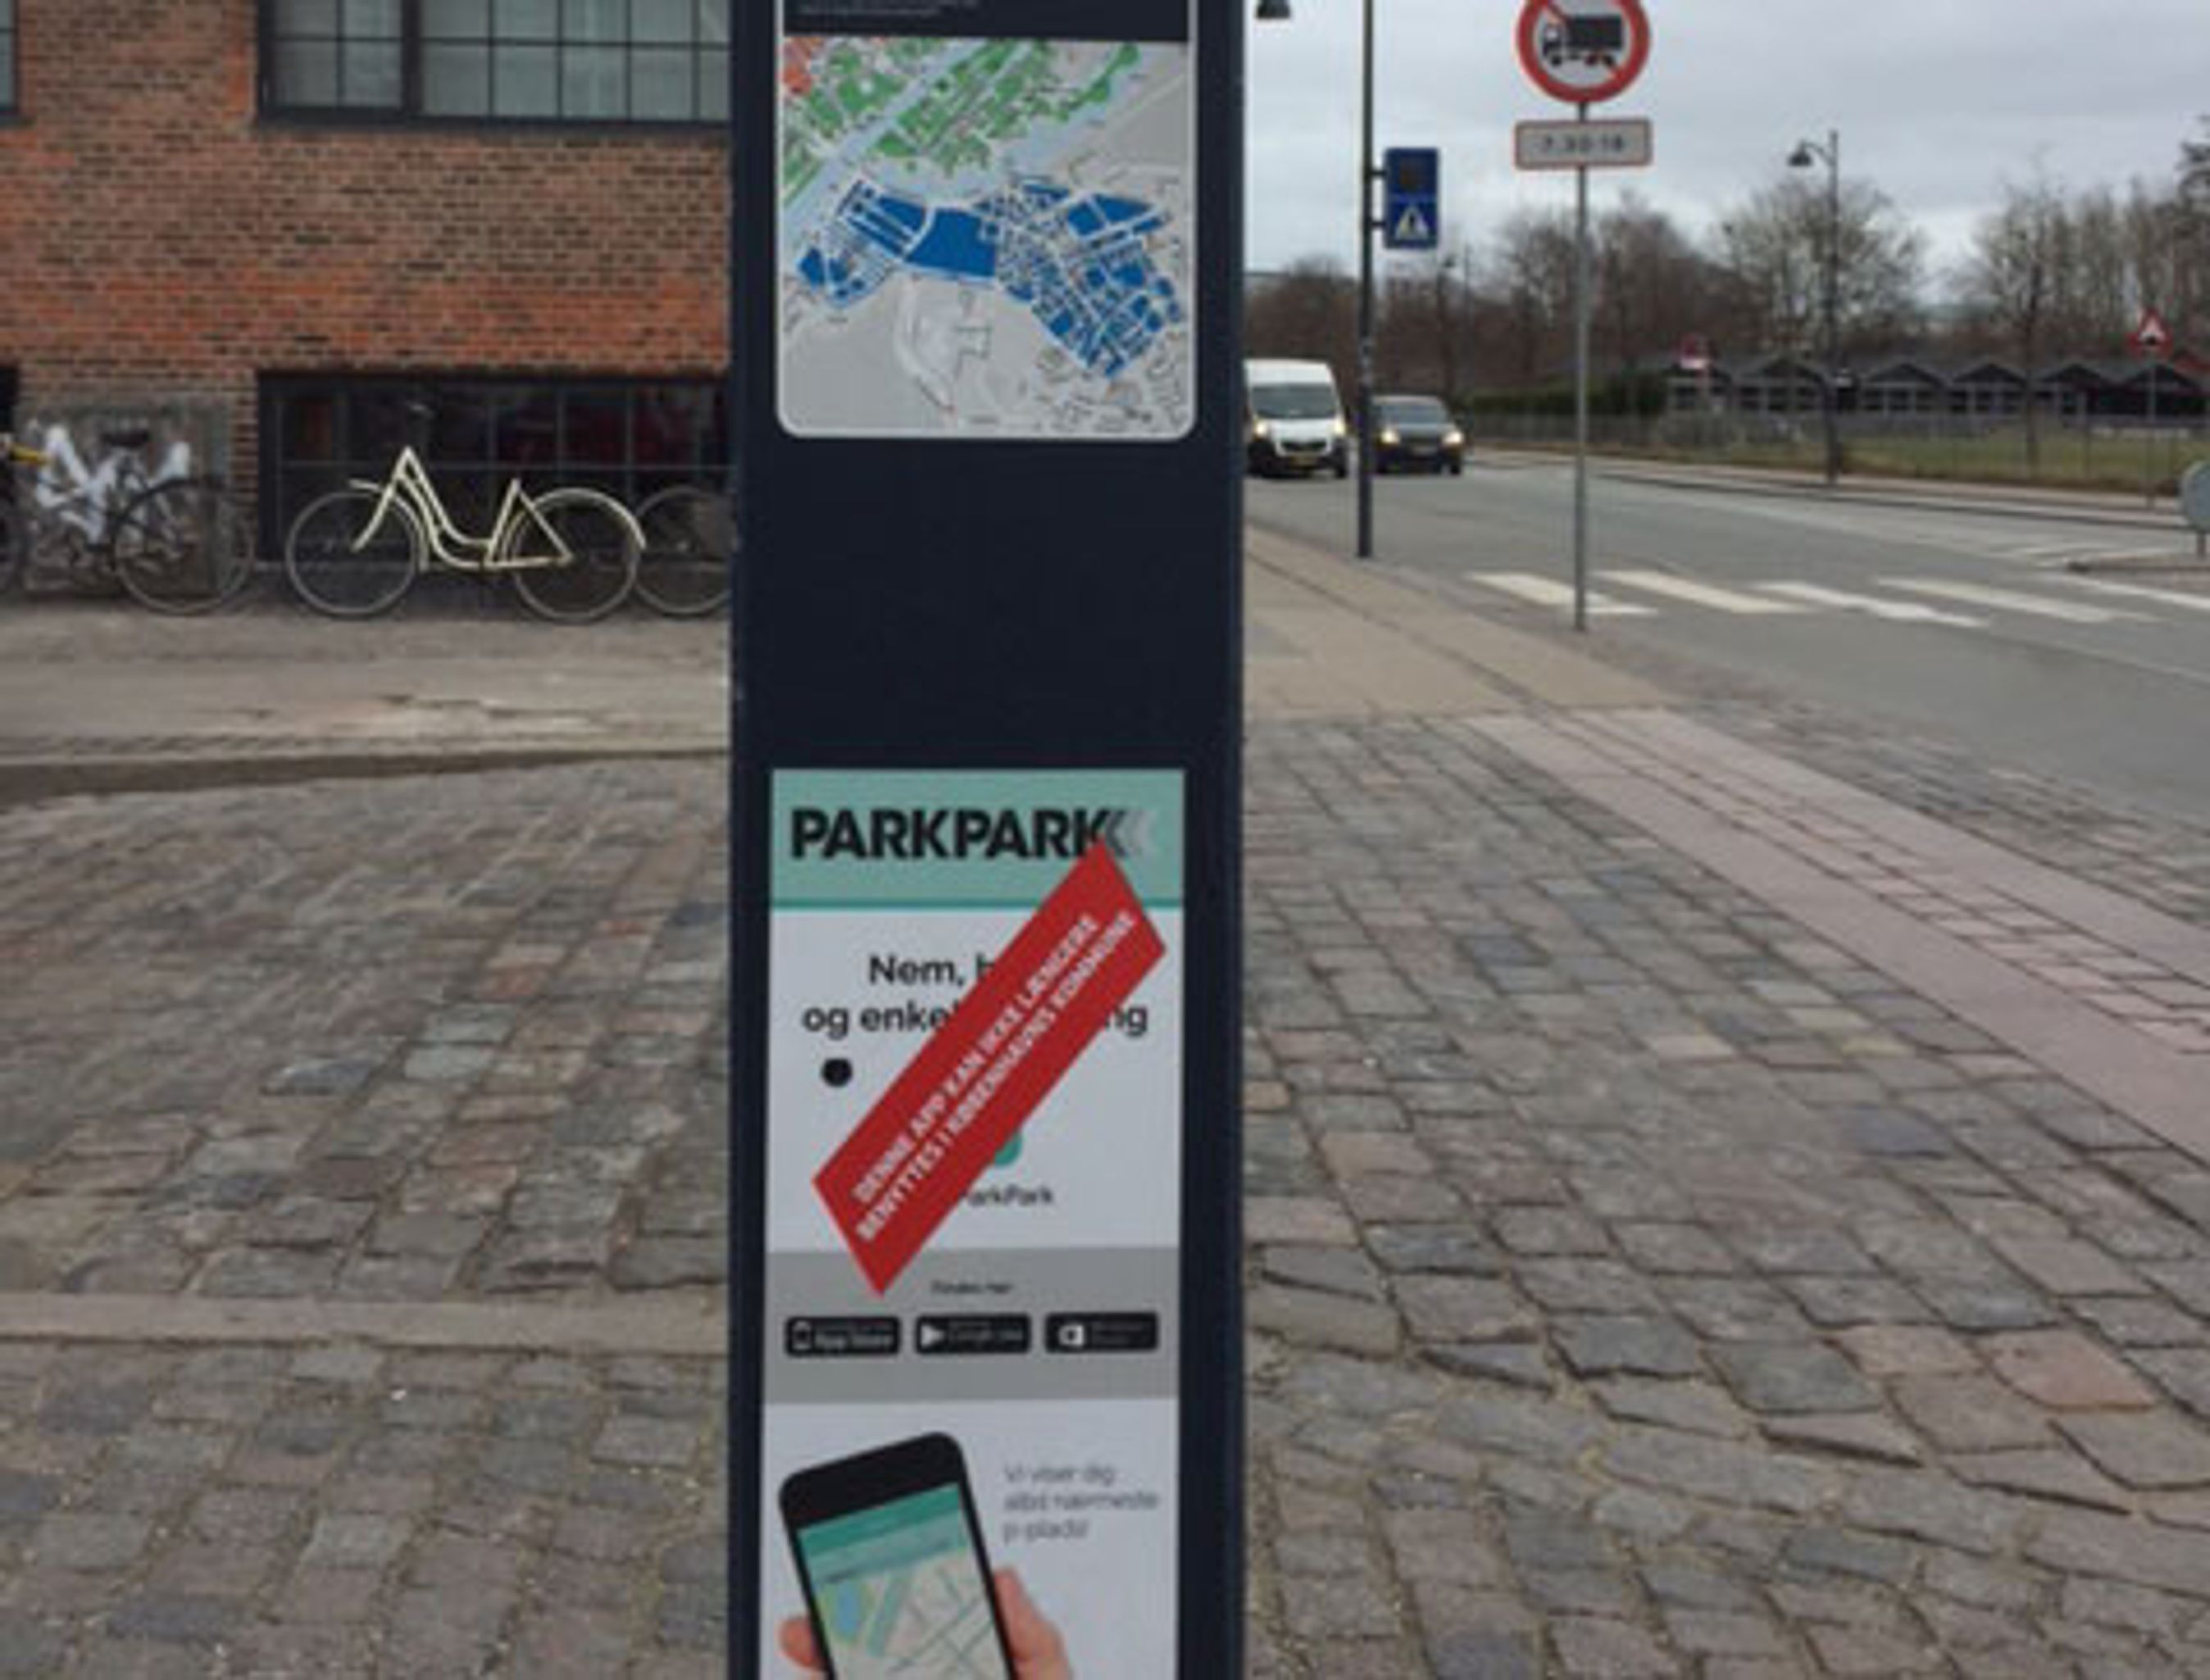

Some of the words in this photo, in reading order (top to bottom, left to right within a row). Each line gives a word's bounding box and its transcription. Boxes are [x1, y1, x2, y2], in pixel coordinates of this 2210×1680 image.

[790, 806, 1108, 861] PARKPARK
[869, 953, 966, 987] Nem,
[802, 1006, 850, 1039] og
[908, 1088, 948, 1139] APP
[943, 1047, 987, 1097] KAN
[961, 1183, 1054, 1207] arkPark
